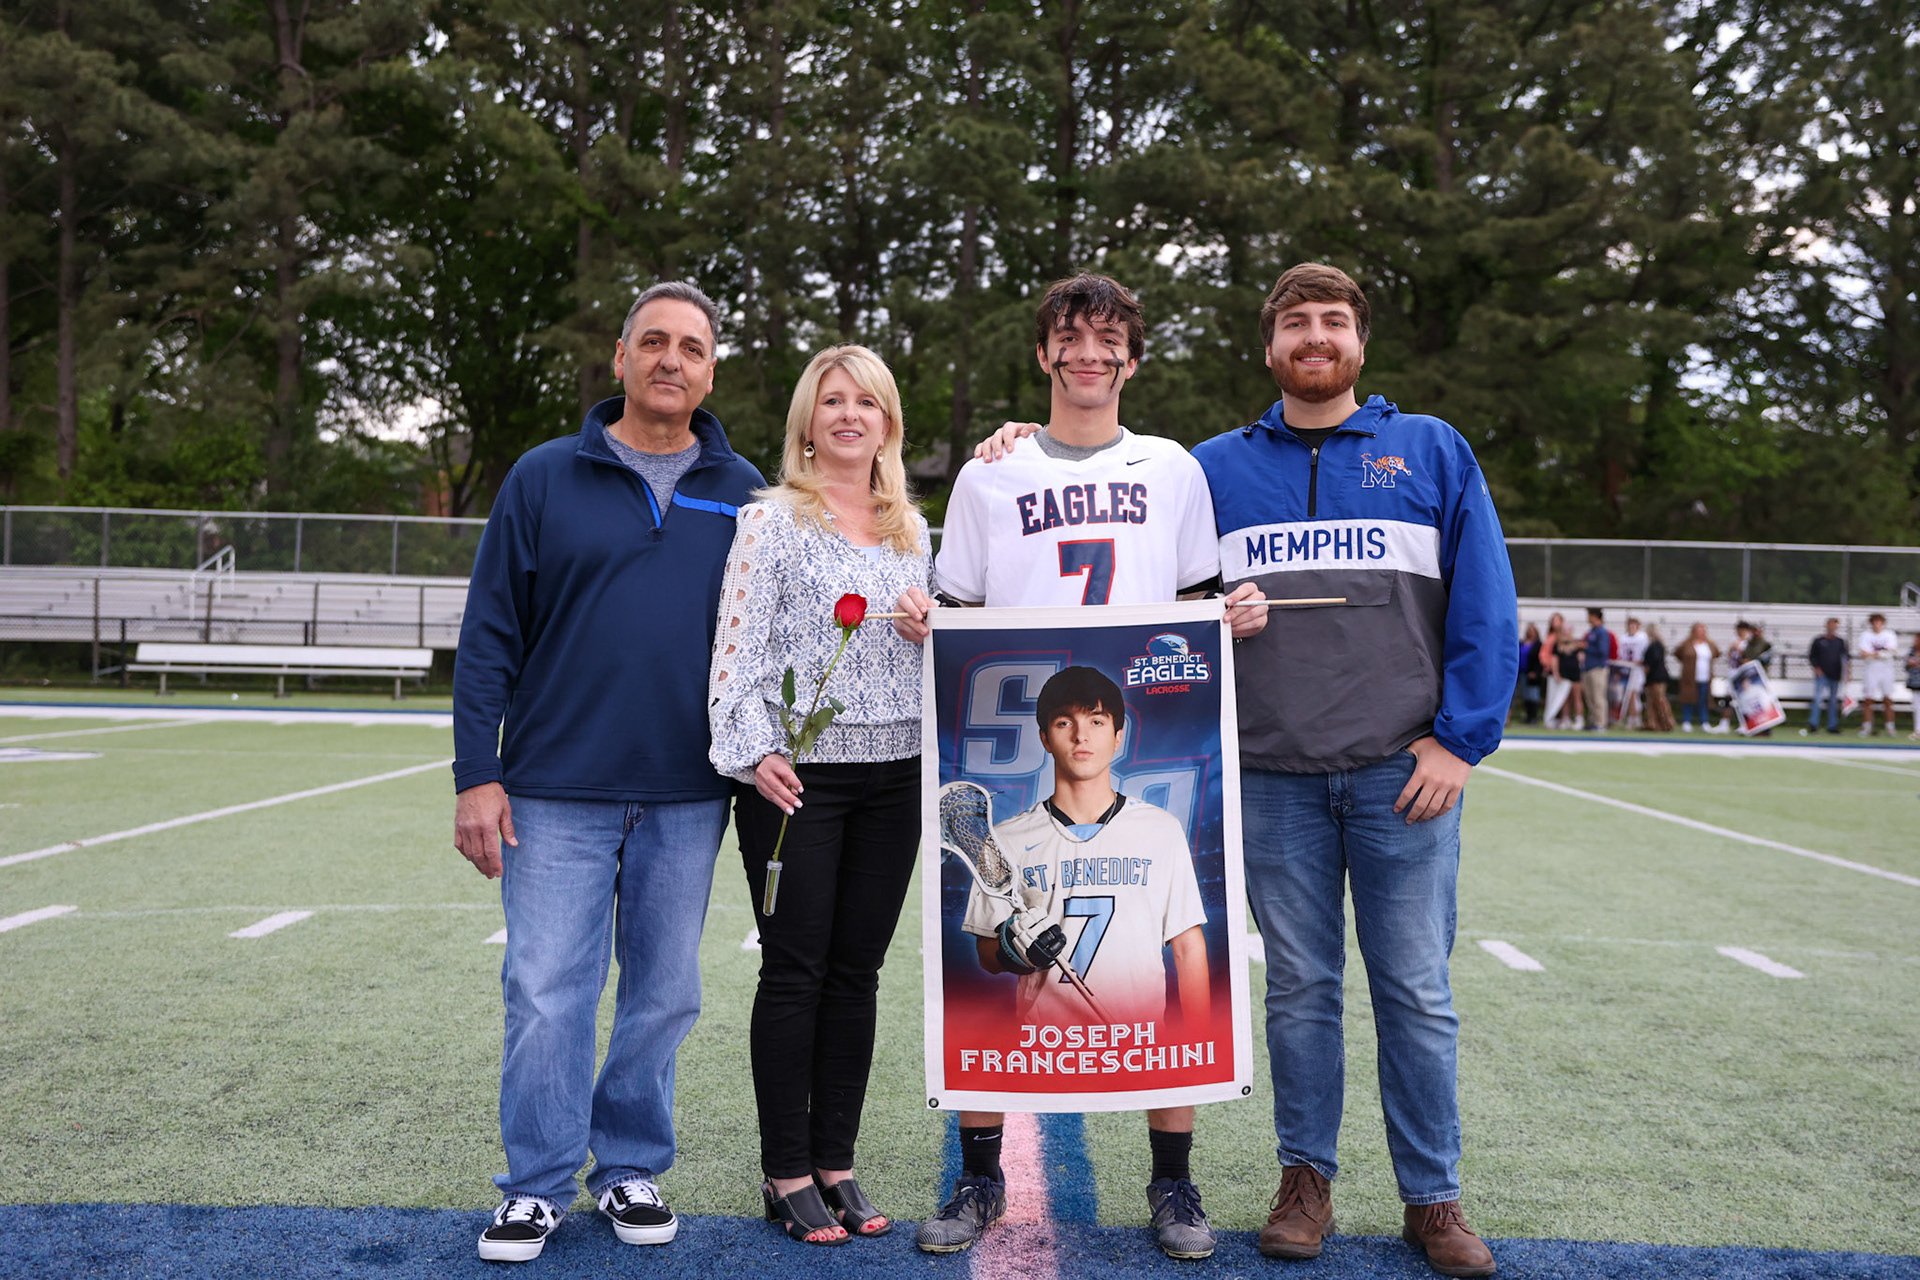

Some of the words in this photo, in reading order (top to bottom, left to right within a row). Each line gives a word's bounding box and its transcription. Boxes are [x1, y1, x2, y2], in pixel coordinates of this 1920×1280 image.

[1362, 460, 1395, 488] M
[1016, 482, 1147, 536] EAGLES
[1245, 527, 1385, 568] MEMPHIS
[1057, 538, 1116, 606] 7
[1126, 663, 1209, 686] EAGLES
[1134, 657, 1149, 667] ST.
[1151, 654, 1202, 665] BENEDICT
[1145, 684, 1190, 695] LACROSSE
[1061, 857, 1152, 888] BENEDICT
[1058, 895, 1116, 983] 7
[1019, 1021, 1156, 1049] JOSEPH
[959, 1041, 1216, 1075] FRANCESCHINI
